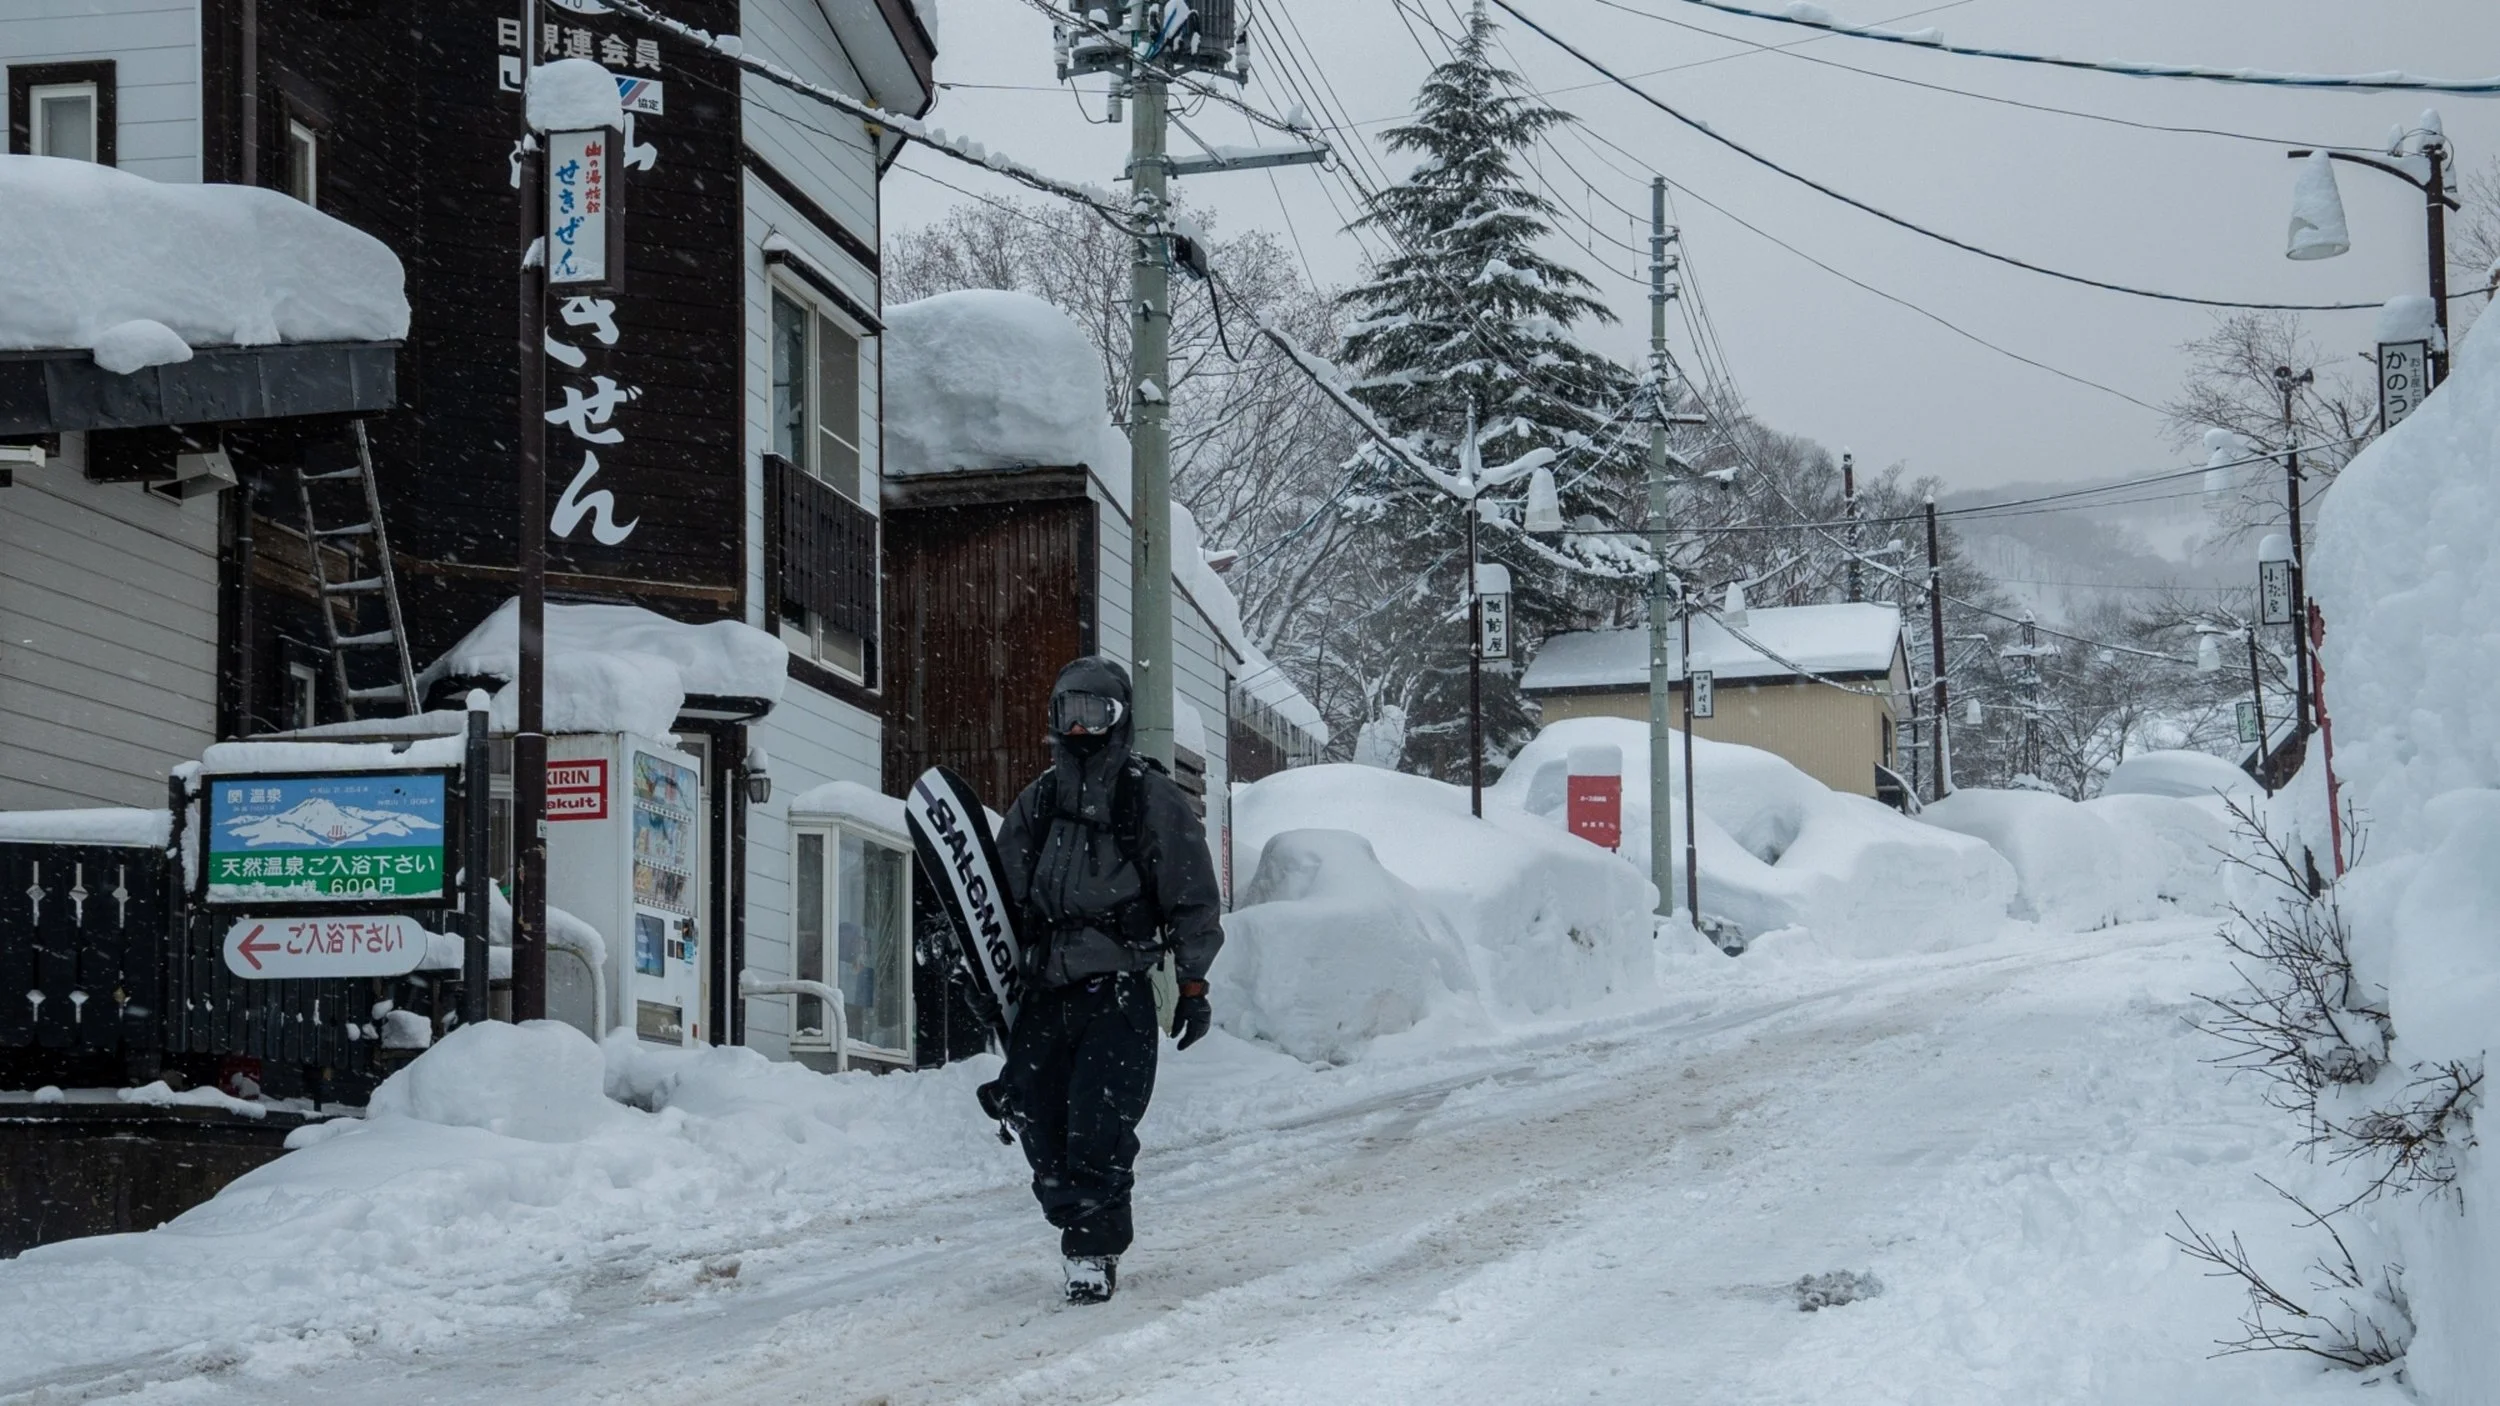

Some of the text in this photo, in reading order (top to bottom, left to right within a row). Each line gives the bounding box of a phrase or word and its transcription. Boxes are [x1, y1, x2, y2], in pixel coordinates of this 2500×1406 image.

[554, 159, 585, 275] せきぜん
[547, 797, 597, 810] akult
[220, 855, 436, 878] 天然温泉ご入浴下さい
[926, 797, 1026, 1006] SALOMON
[286, 922, 404, 955] ご入浴下さい
